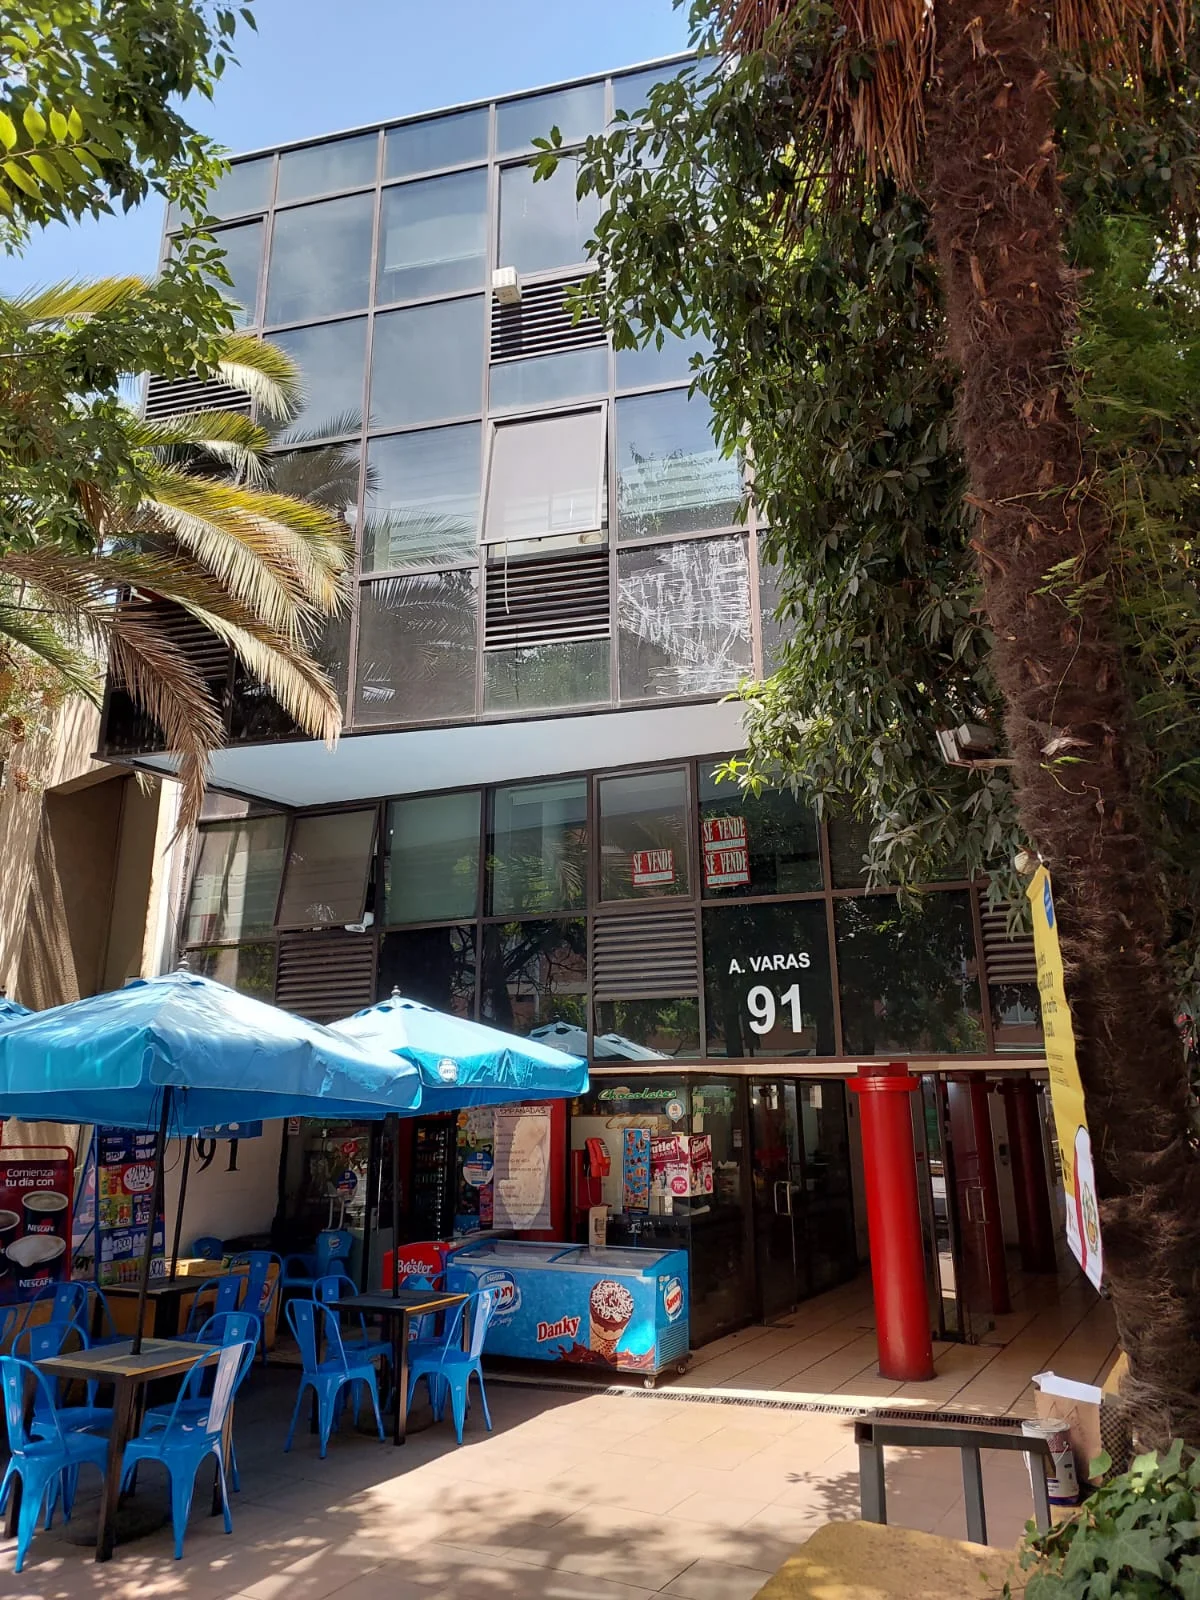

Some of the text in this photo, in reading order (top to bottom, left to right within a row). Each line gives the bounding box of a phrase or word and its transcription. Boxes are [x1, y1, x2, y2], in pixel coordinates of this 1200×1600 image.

[704, 817, 746, 841] SE VENDE
[633, 850, 673, 873] SE VENDE
[705, 851, 748, 875] SE VENDE
[729, 952, 811, 975] A. VARAS
[747, 983, 802, 1035] 91
[598, 1087, 677, 1101] Chocolates
[196, 1138, 240, 1174] 91
[651, 1139, 677, 1154] utlet
[5, 1178, 17, 1187] tu
[36, 1178, 55, 1186] con
[6, 1168, 54, 1178] Comienza
[398, 1258, 433, 1274] Bresler
[538, 1315, 580, 1341] Danky
